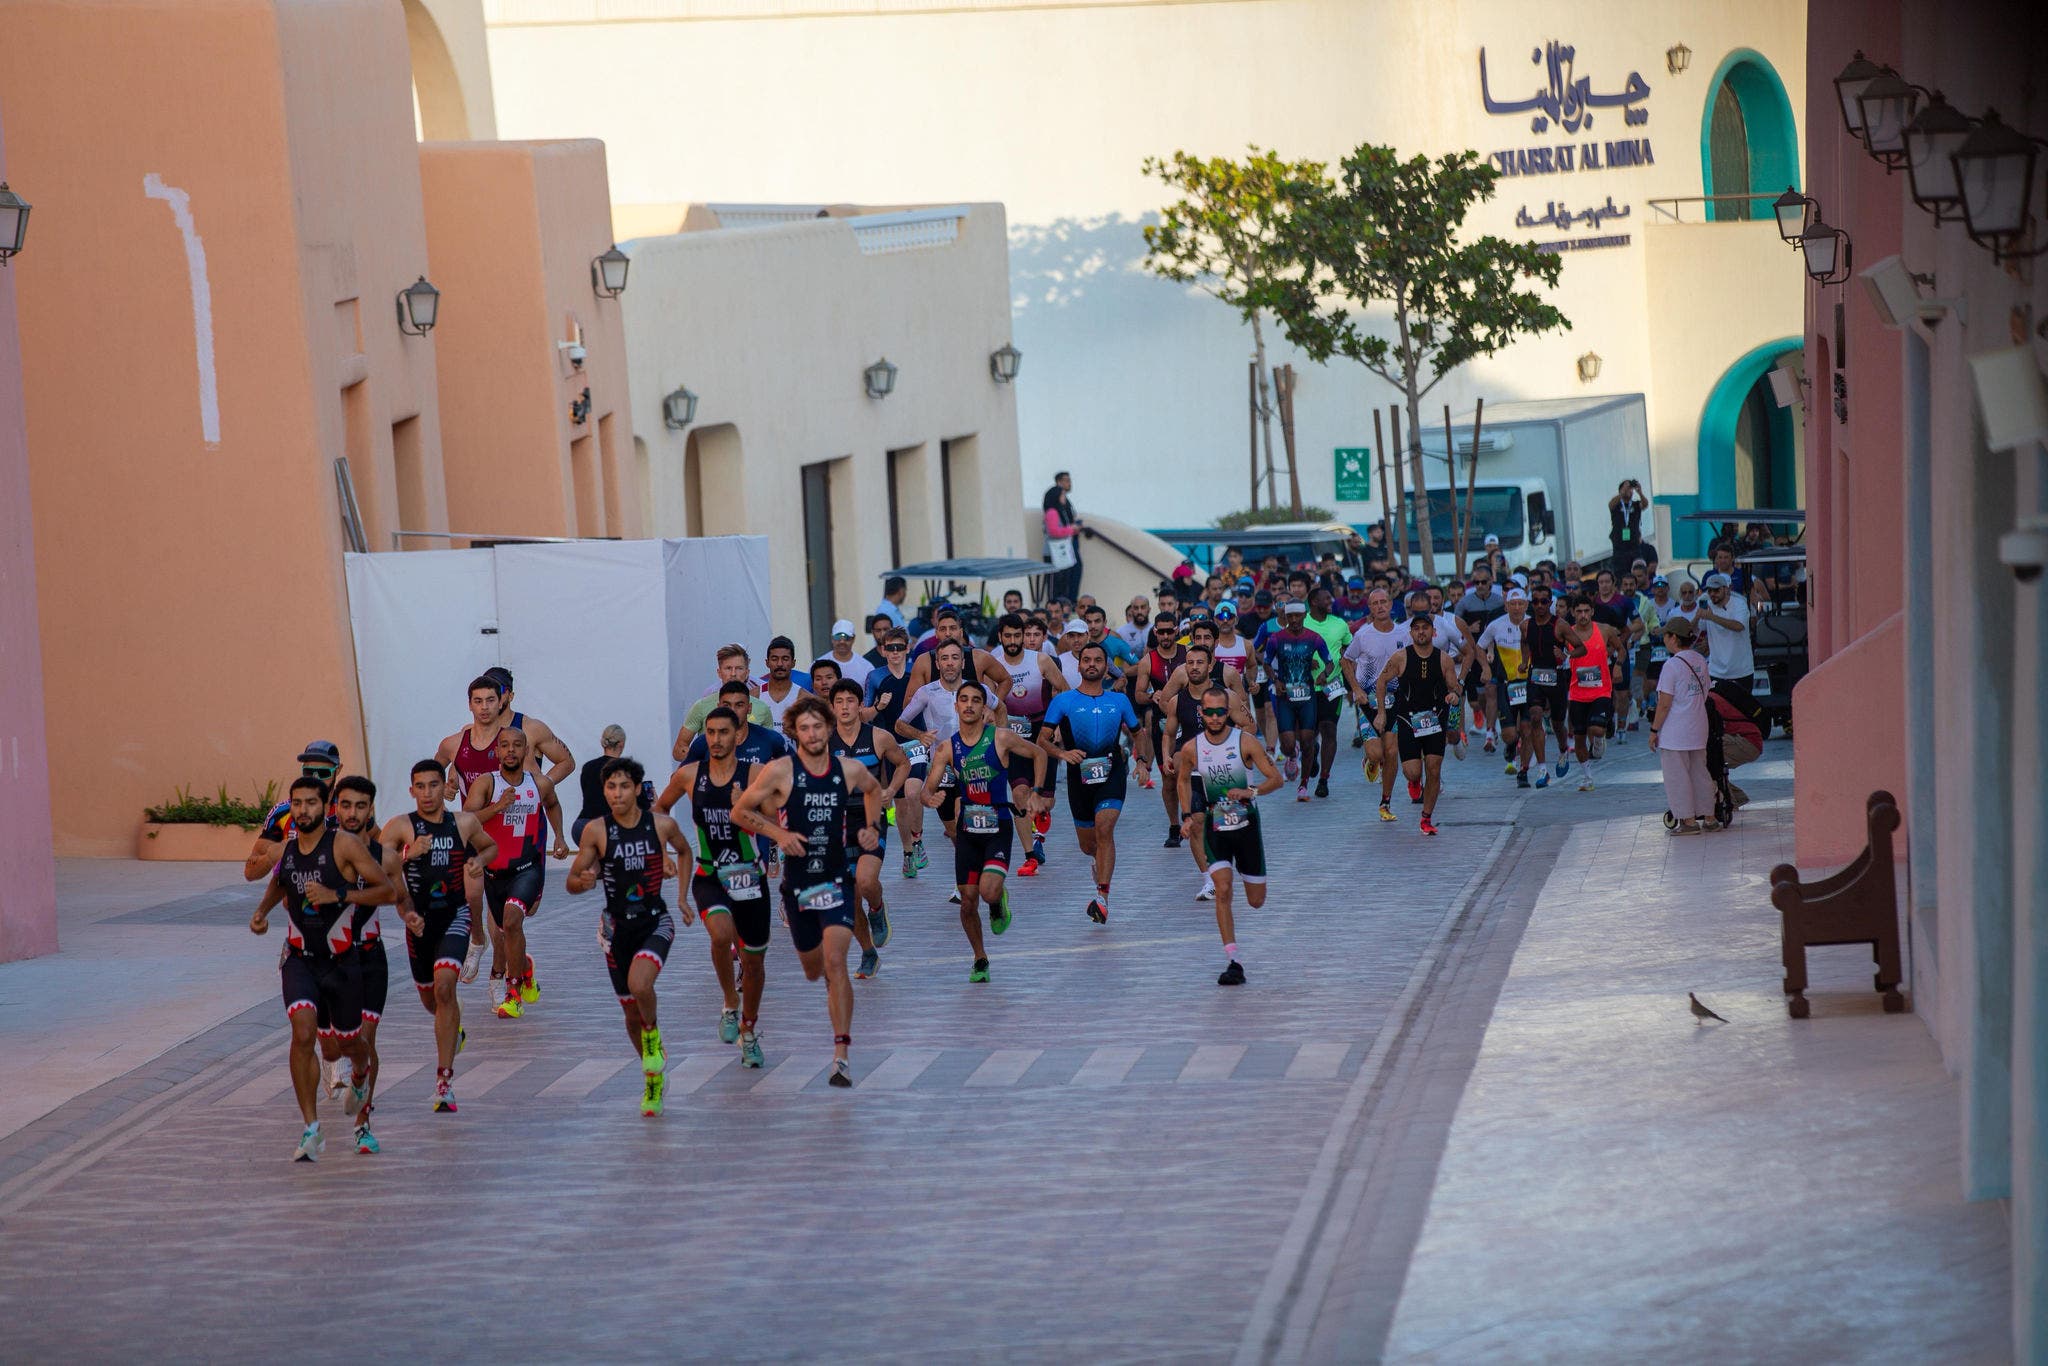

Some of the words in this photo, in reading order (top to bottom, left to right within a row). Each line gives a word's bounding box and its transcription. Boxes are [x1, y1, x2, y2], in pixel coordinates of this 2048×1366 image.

[1580, 142, 1605, 170] AL
[1605, 138, 1655, 169] MINA
[1010, 723, 1023, 733] 52
[961, 766, 992, 781] ALENEZI
[1091, 766, 1105, 779] 31
[1207, 763, 1233, 777] NAIF
[968, 781, 988, 795] KUW
[1209, 774, 1236, 787] KSA
[804, 792, 838, 807] PRICE
[505, 814, 526, 826] BRN
[807, 807, 832, 822] GBR
[973, 815, 987, 828] 61
[709, 824, 732, 841] PLE
[613, 840, 655, 860] ADEL
[430, 850, 450, 866] BRN
[624, 856, 645, 872] BRN
[291, 869, 322, 884] OMAR
[728, 873, 751, 890] 120
[809, 893, 833, 907] 143
